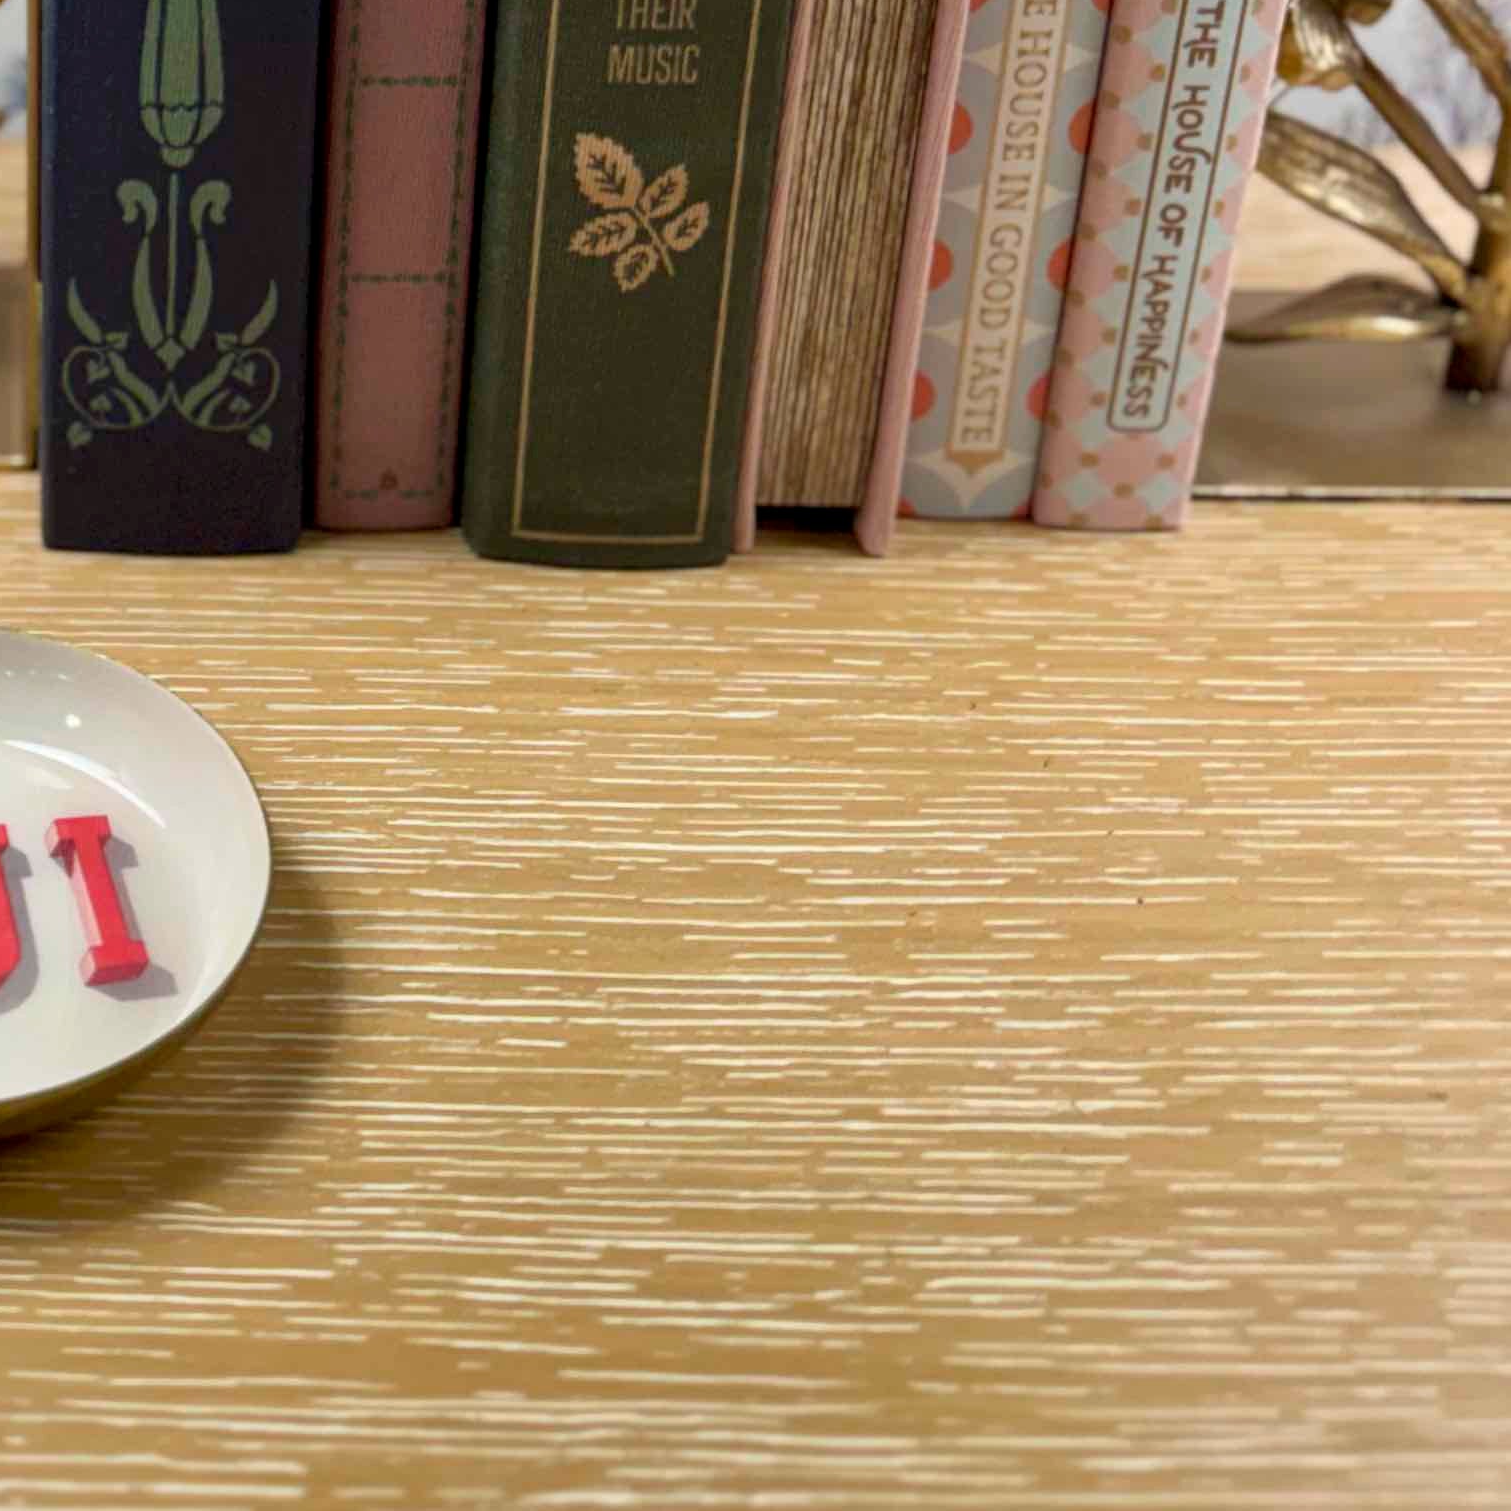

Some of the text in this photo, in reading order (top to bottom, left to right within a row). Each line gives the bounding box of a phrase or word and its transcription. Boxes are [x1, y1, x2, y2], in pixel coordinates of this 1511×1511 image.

[606, 43, 700, 86] MUSIC
[1002, 27, 1053, 163] HOUSE
[994, 172, 1029, 215] IN
[1164, 84, 1212, 195] HOUSE
[975, 223, 1023, 331] GOOD
[1158, 201, 1187, 248] OF
[1123, 254, 1179, 419] HAPPINESS
[961, 338, 1005, 446] TASTE
